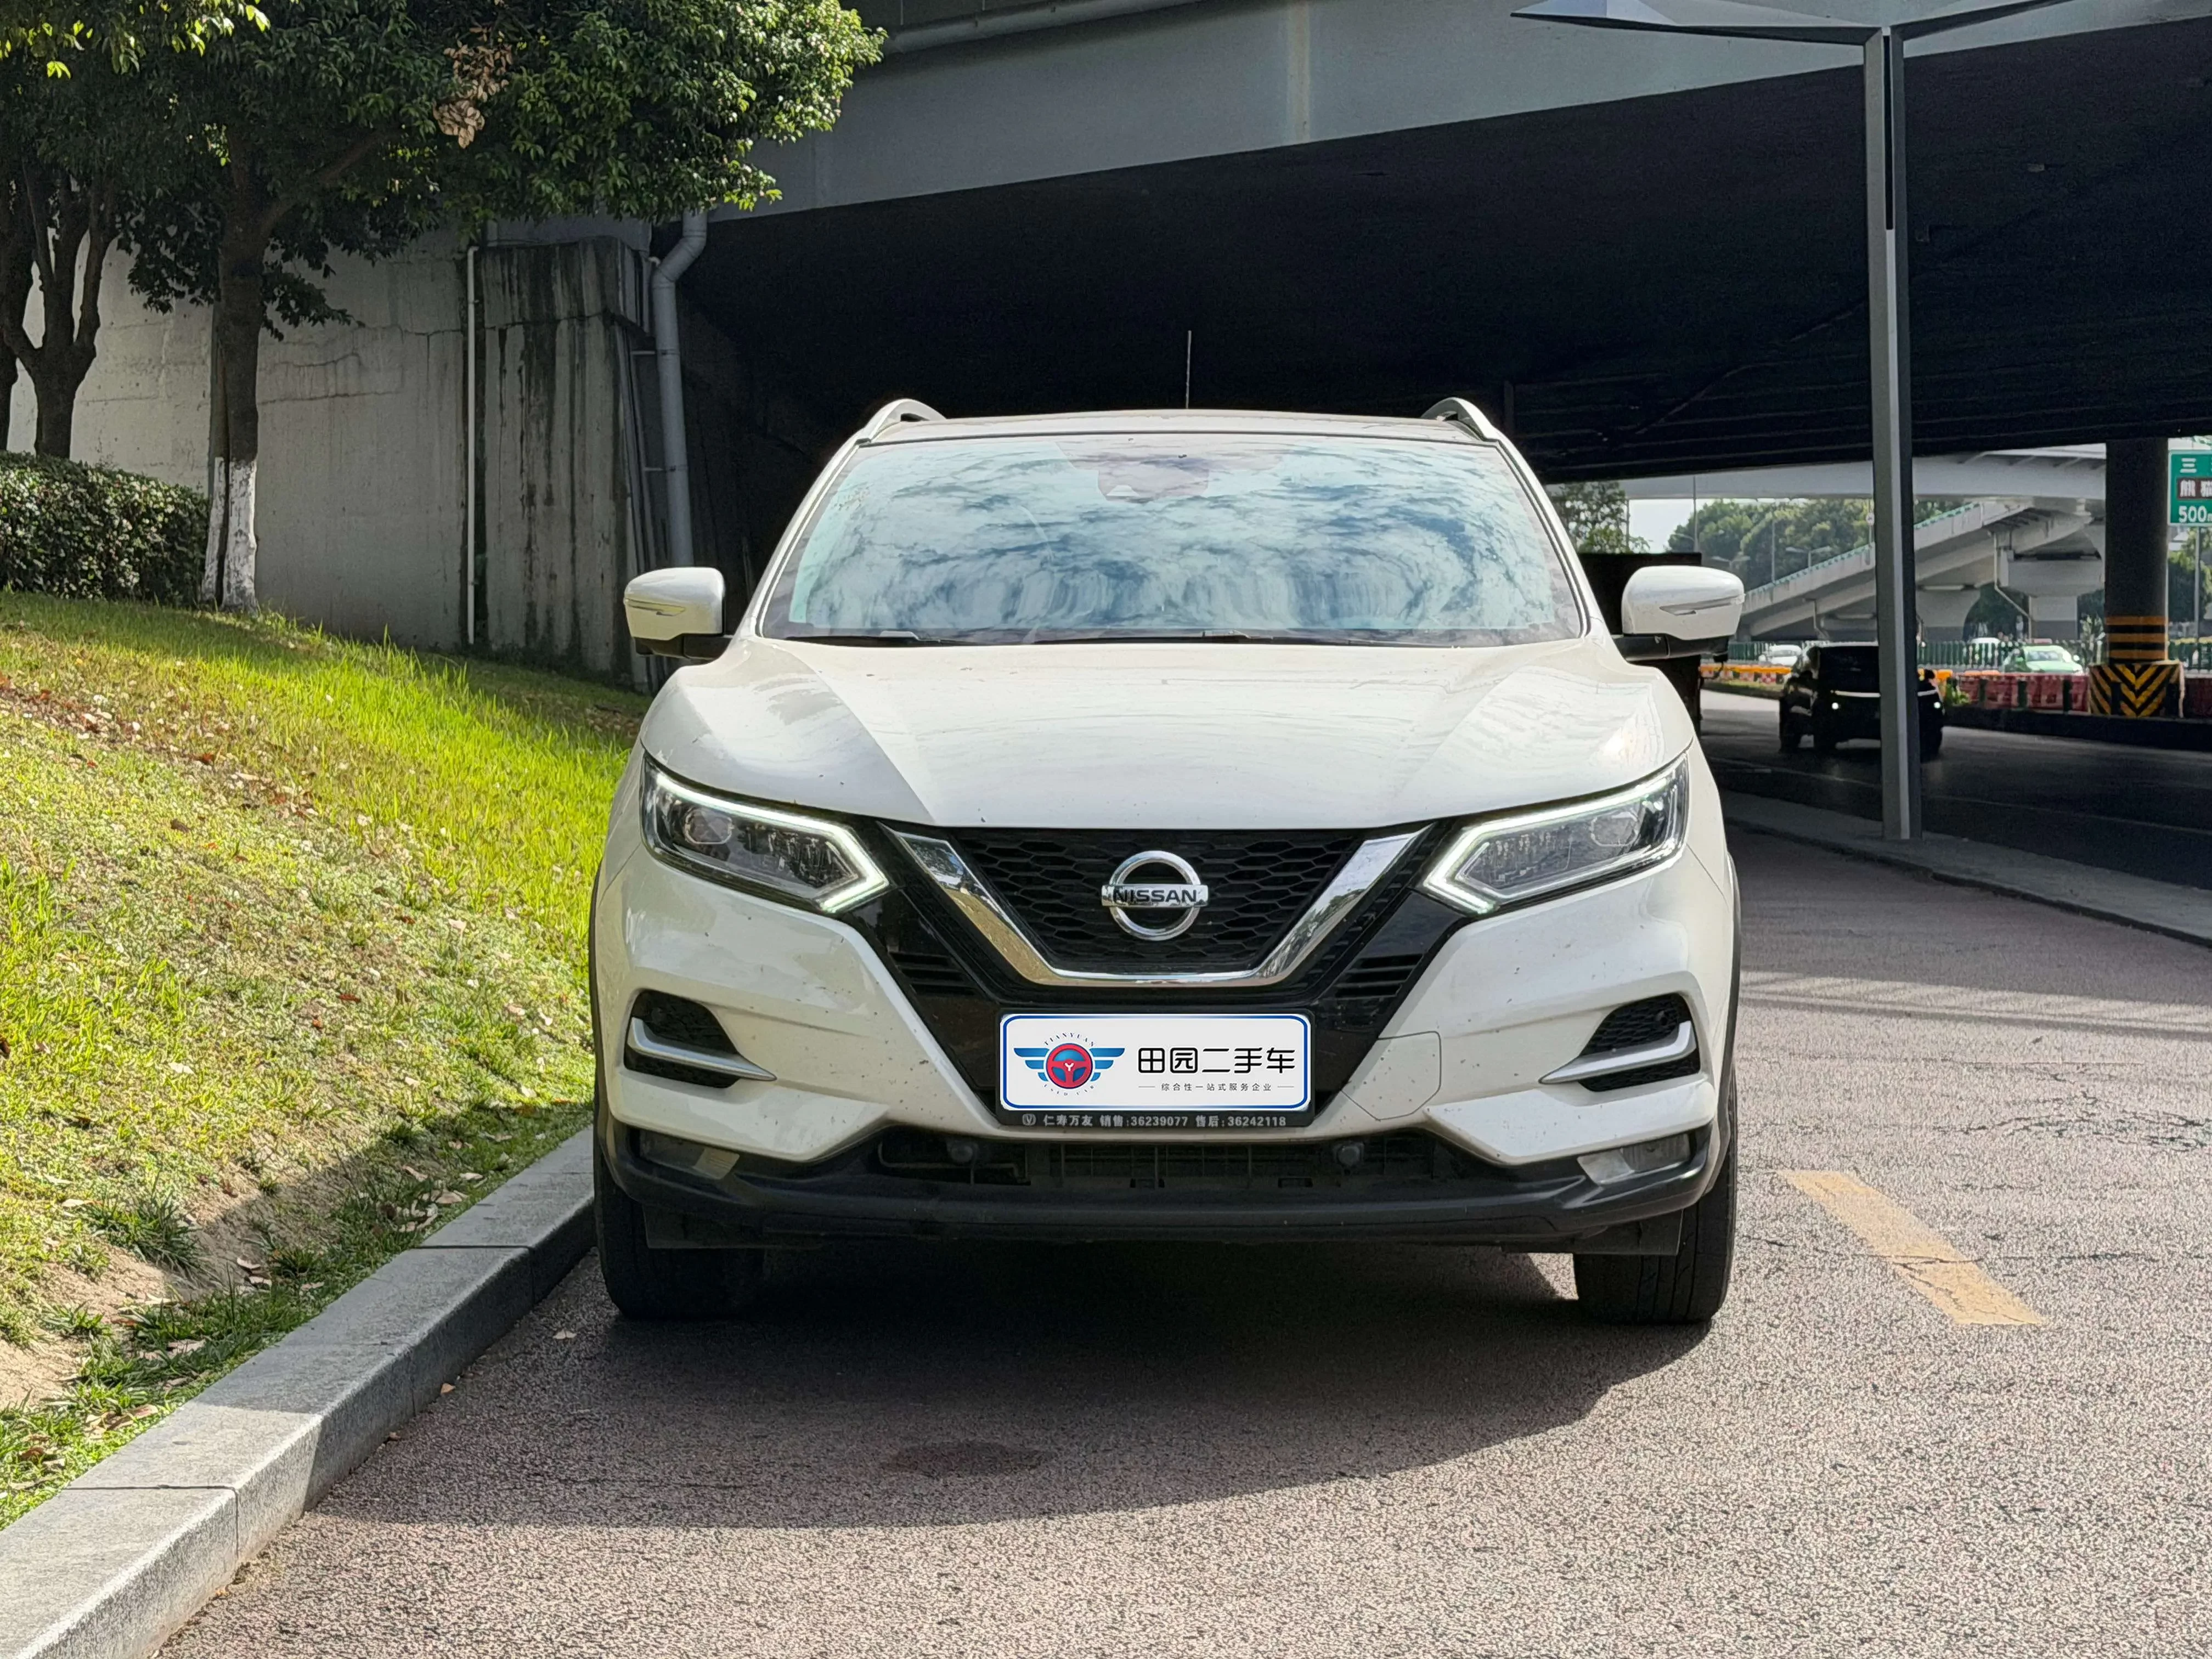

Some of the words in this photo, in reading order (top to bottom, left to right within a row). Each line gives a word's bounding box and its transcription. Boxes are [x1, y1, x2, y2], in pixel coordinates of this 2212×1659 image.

[1113, 889, 1197, 902] NISSAN
[1043, 1115, 1093, 1126] 仁寿万友
